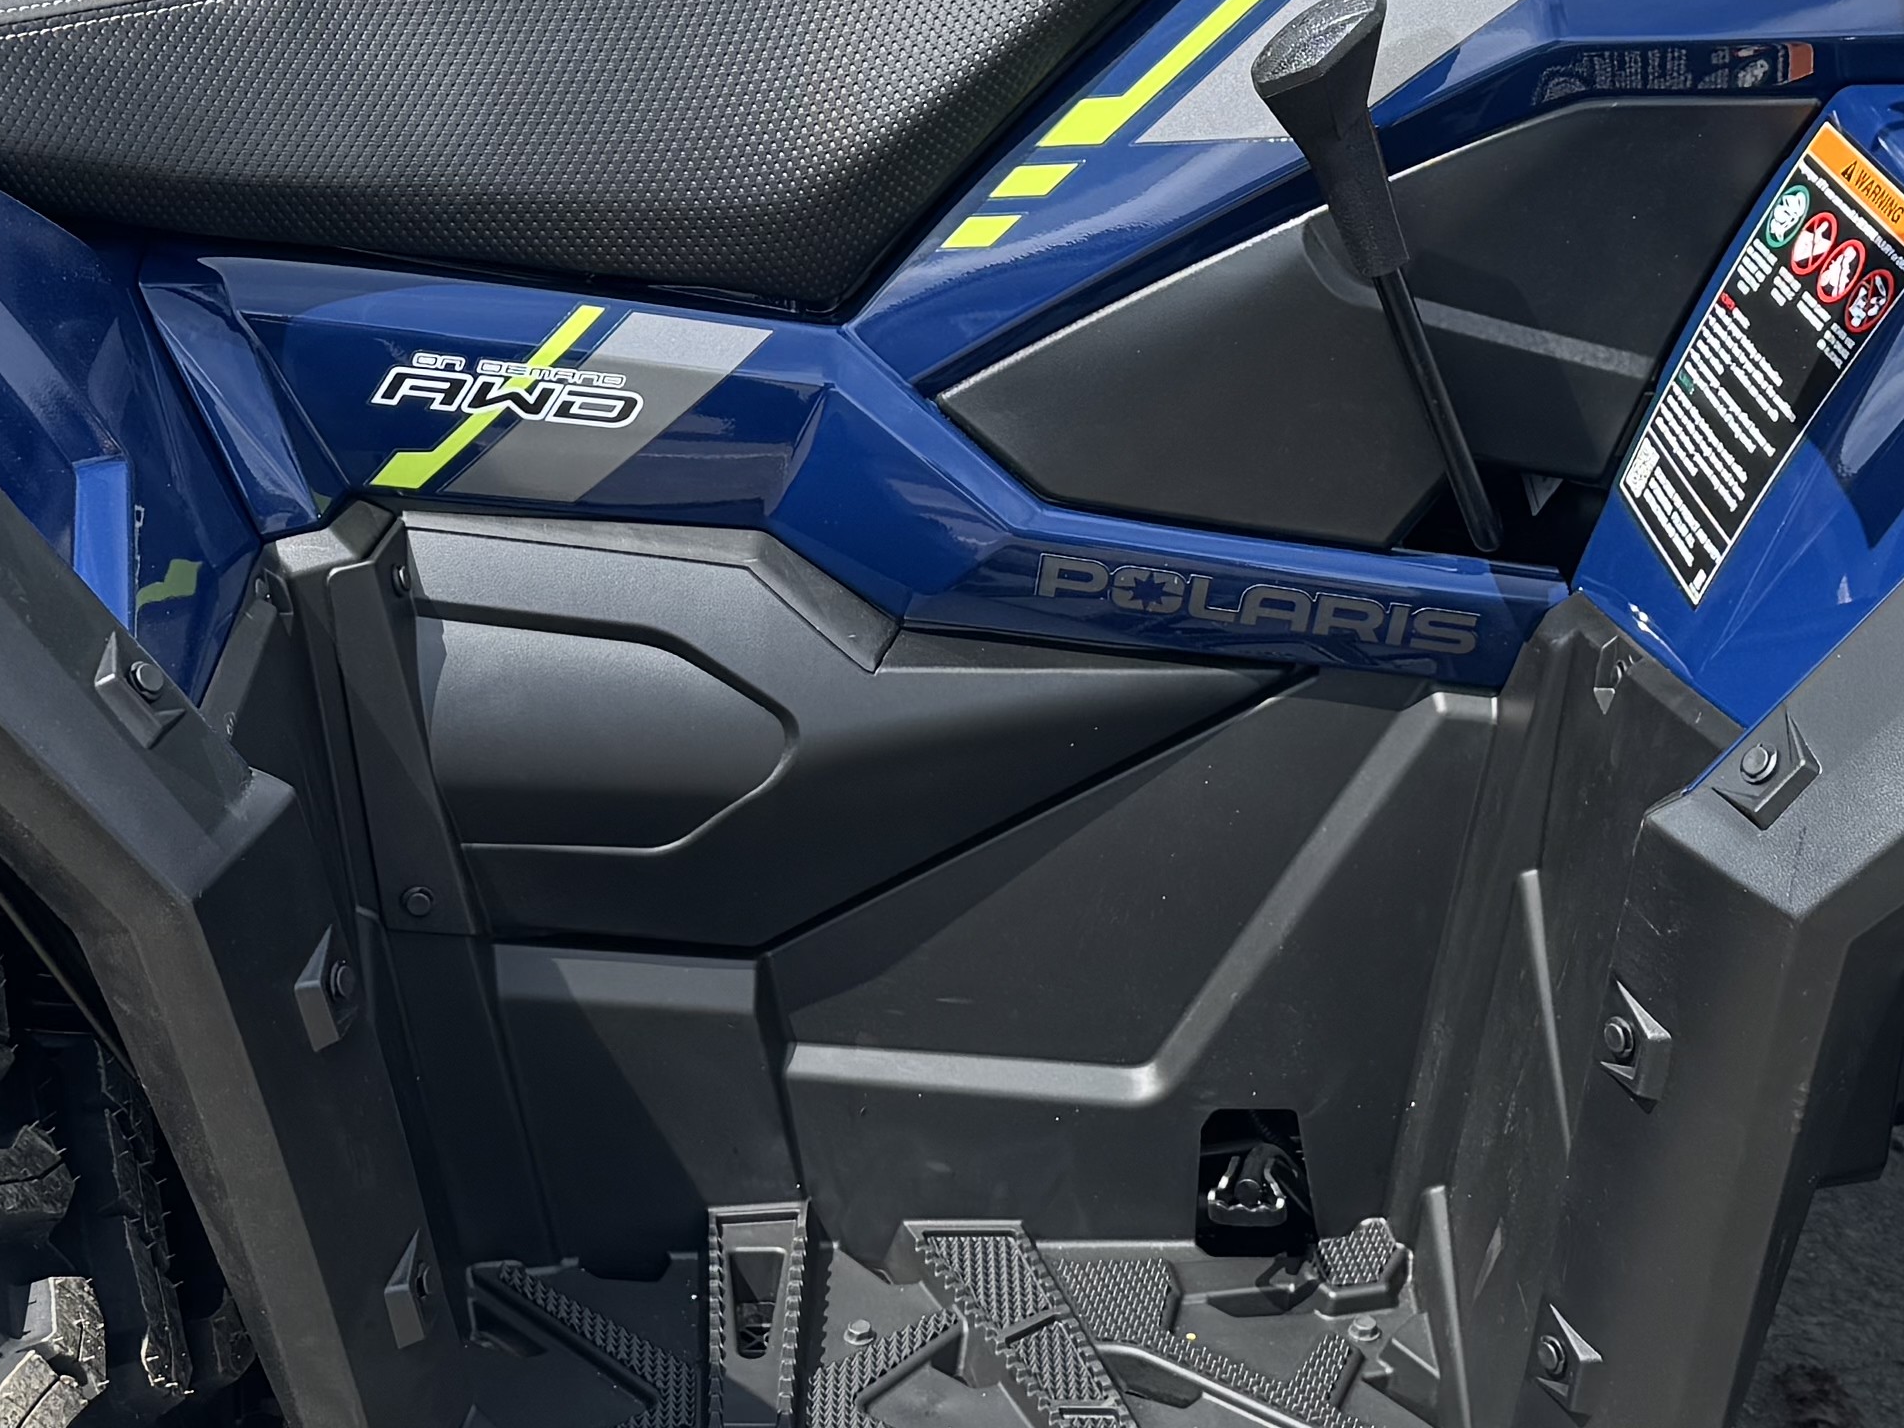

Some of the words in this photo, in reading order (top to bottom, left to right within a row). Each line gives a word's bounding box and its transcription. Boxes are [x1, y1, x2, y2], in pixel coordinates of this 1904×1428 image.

[370, 366, 645, 429] AWD
[411, 353, 466, 372] ON
[476, 359, 628, 388] DEMAND
[1034, 553, 1482, 655] POLARIS
